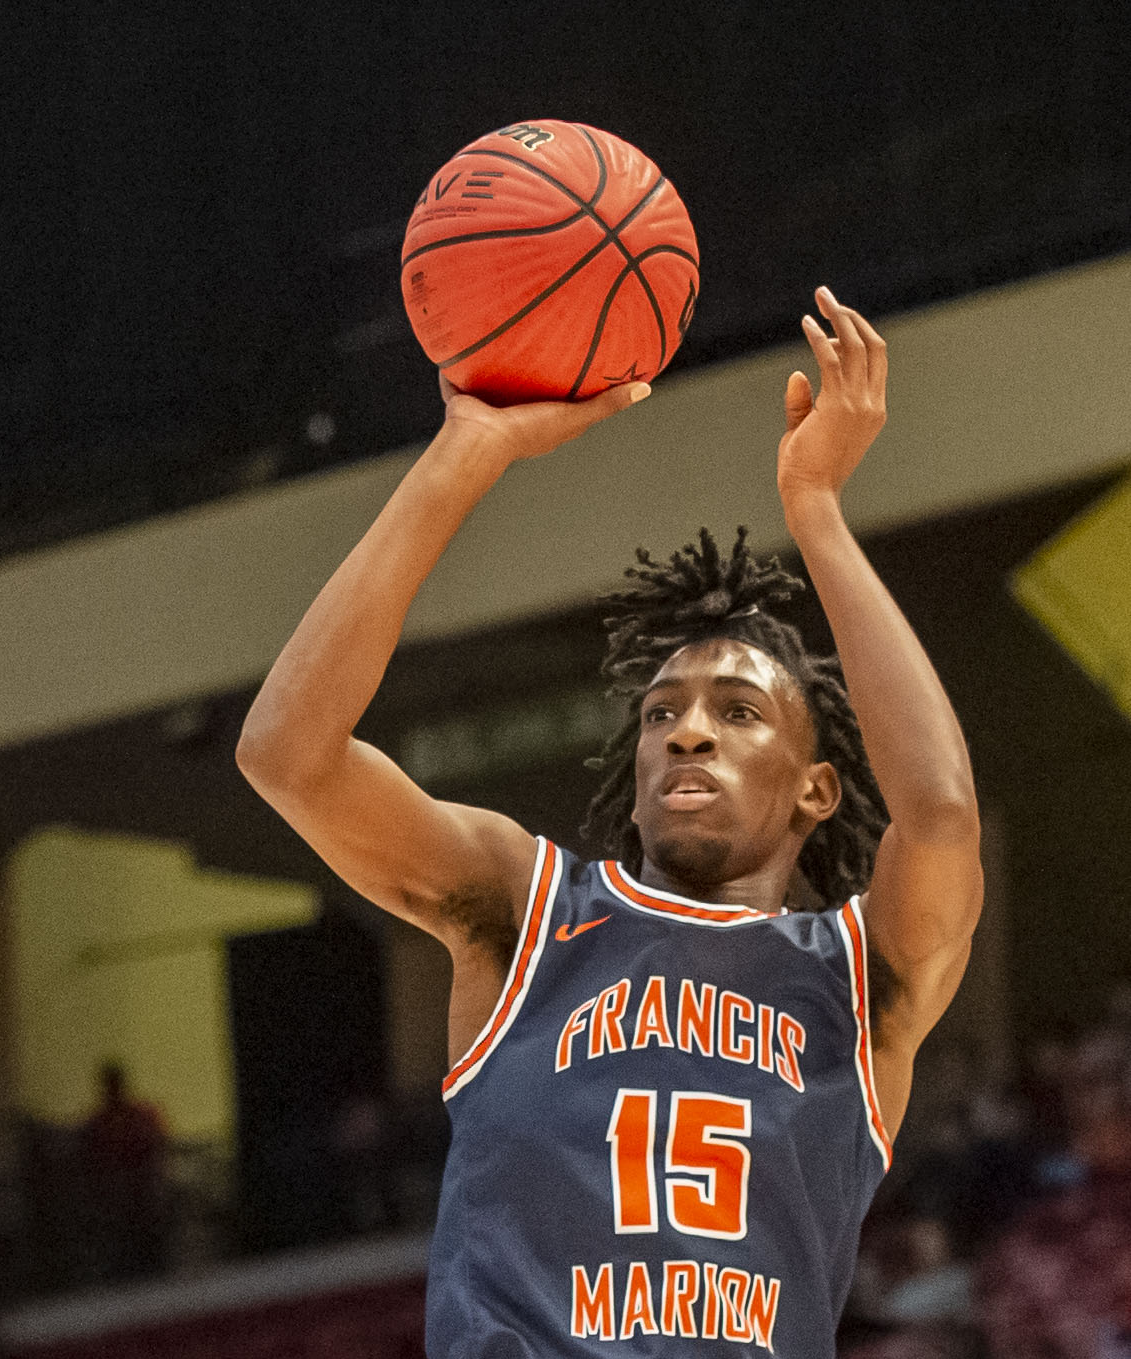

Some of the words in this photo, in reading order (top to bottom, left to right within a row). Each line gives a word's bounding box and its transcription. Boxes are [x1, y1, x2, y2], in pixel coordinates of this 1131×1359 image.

[555, 976, 806, 1093] FRANCIS
[606, 1088, 752, 1240] 15
[570, 1260, 780, 1354] MARION
